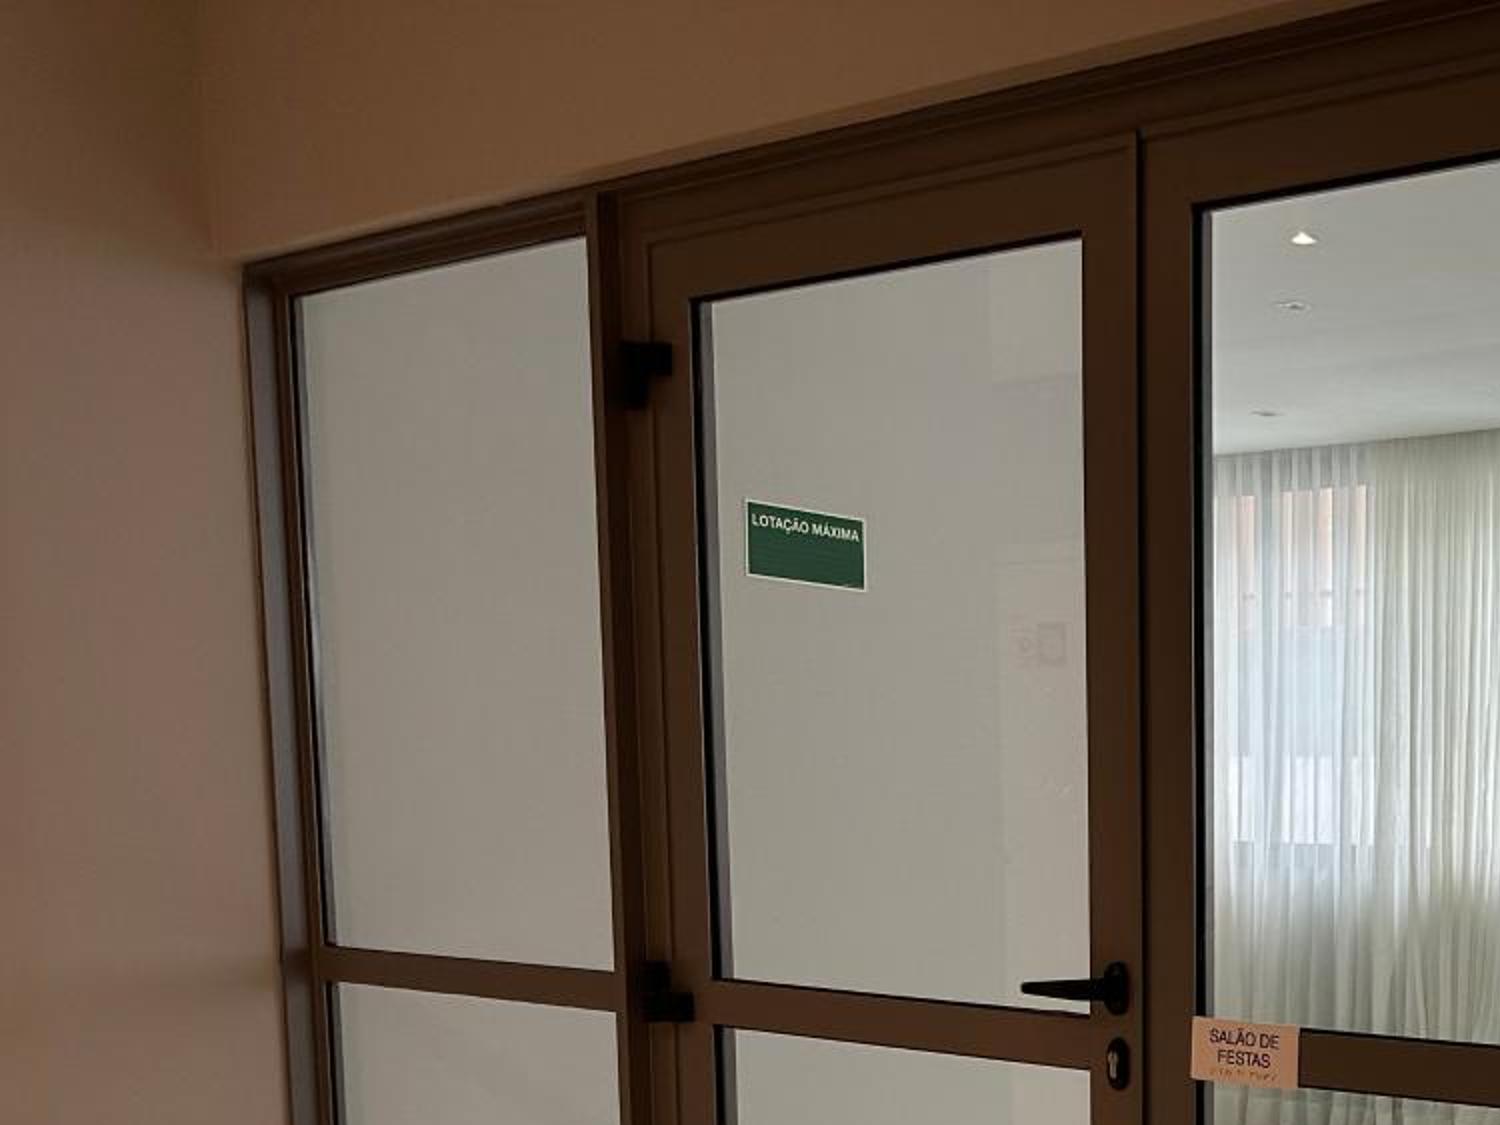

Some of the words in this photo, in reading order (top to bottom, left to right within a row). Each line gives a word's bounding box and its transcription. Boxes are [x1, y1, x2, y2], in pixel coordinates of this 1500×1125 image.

[752, 513, 809, 534] LOTAÇÃO
[812, 522, 860, 542] MÁXIMA
[1209, 1027, 1256, 1047] SALÃO
[1260, 1033, 1280, 1050] DE
[1217, 1049, 1271, 1069] FESTAS
